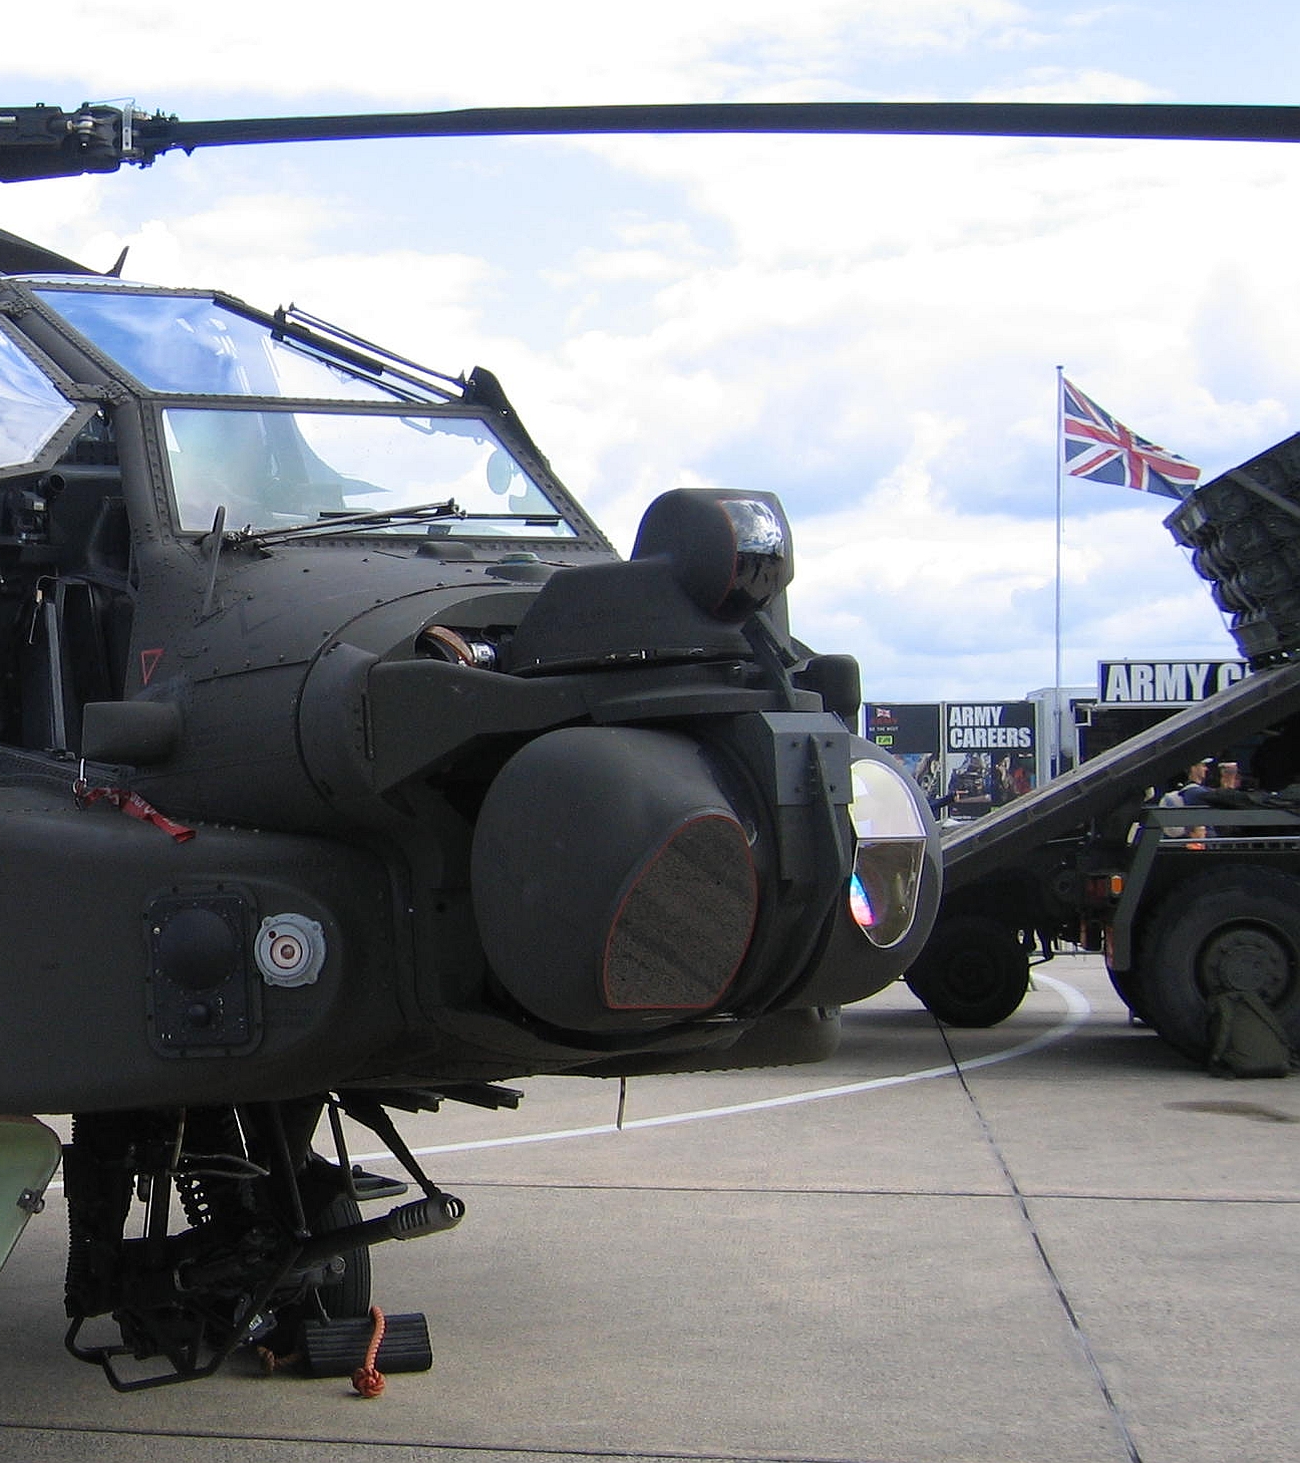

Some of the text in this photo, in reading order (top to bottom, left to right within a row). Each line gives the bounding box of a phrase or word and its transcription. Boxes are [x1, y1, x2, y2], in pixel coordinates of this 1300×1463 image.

[1106, 664, 1209, 702] ARMY
[949, 706, 1002, 726] ARMY
[950, 727, 1031, 749] CAREERS
